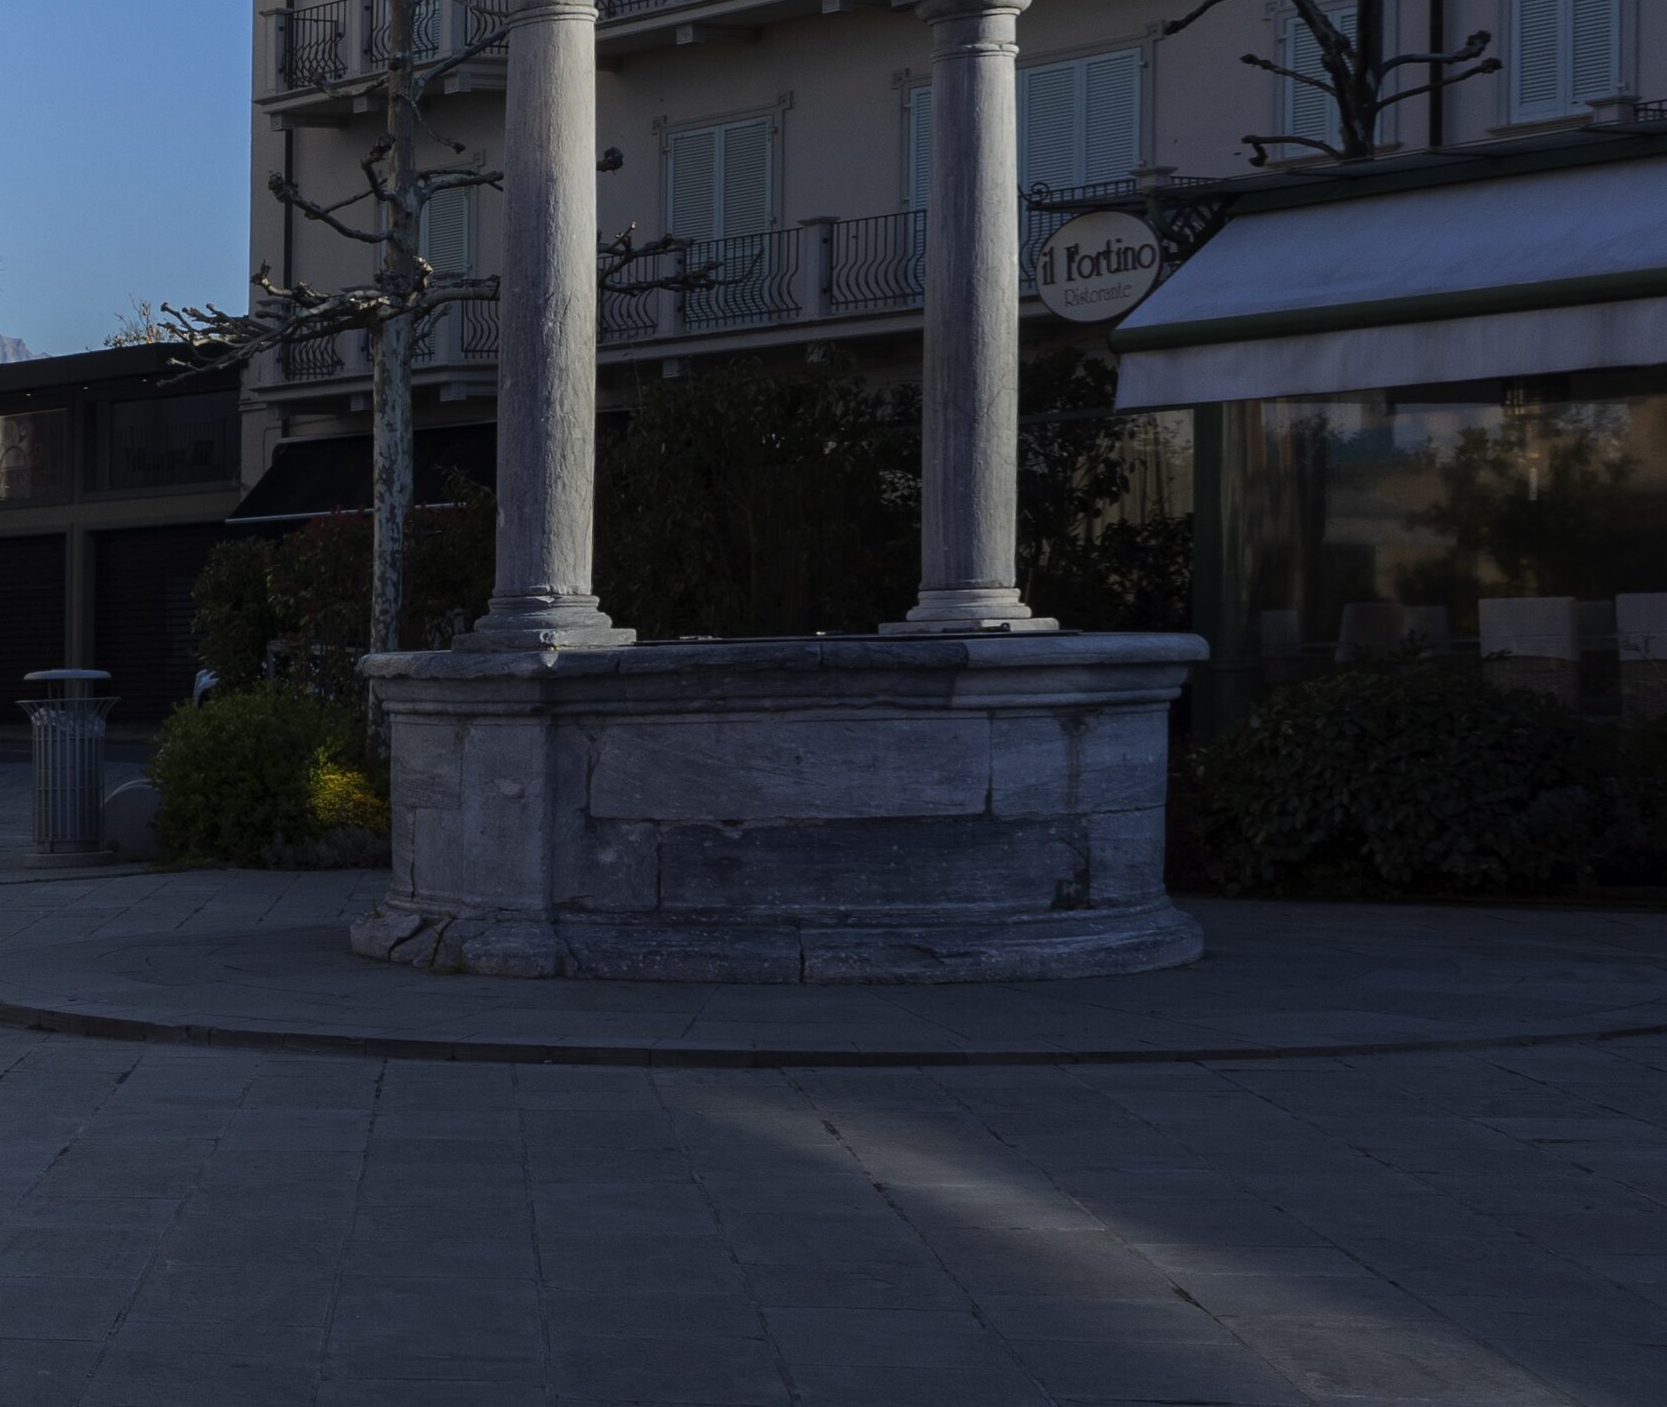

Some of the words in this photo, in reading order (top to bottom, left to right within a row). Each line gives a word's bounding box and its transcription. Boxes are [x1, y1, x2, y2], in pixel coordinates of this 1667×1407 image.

[1041, 246, 1056, 285] il
[1065, 238, 1157, 281] Fortino
[1063, 282, 1132, 307] Ristorante
